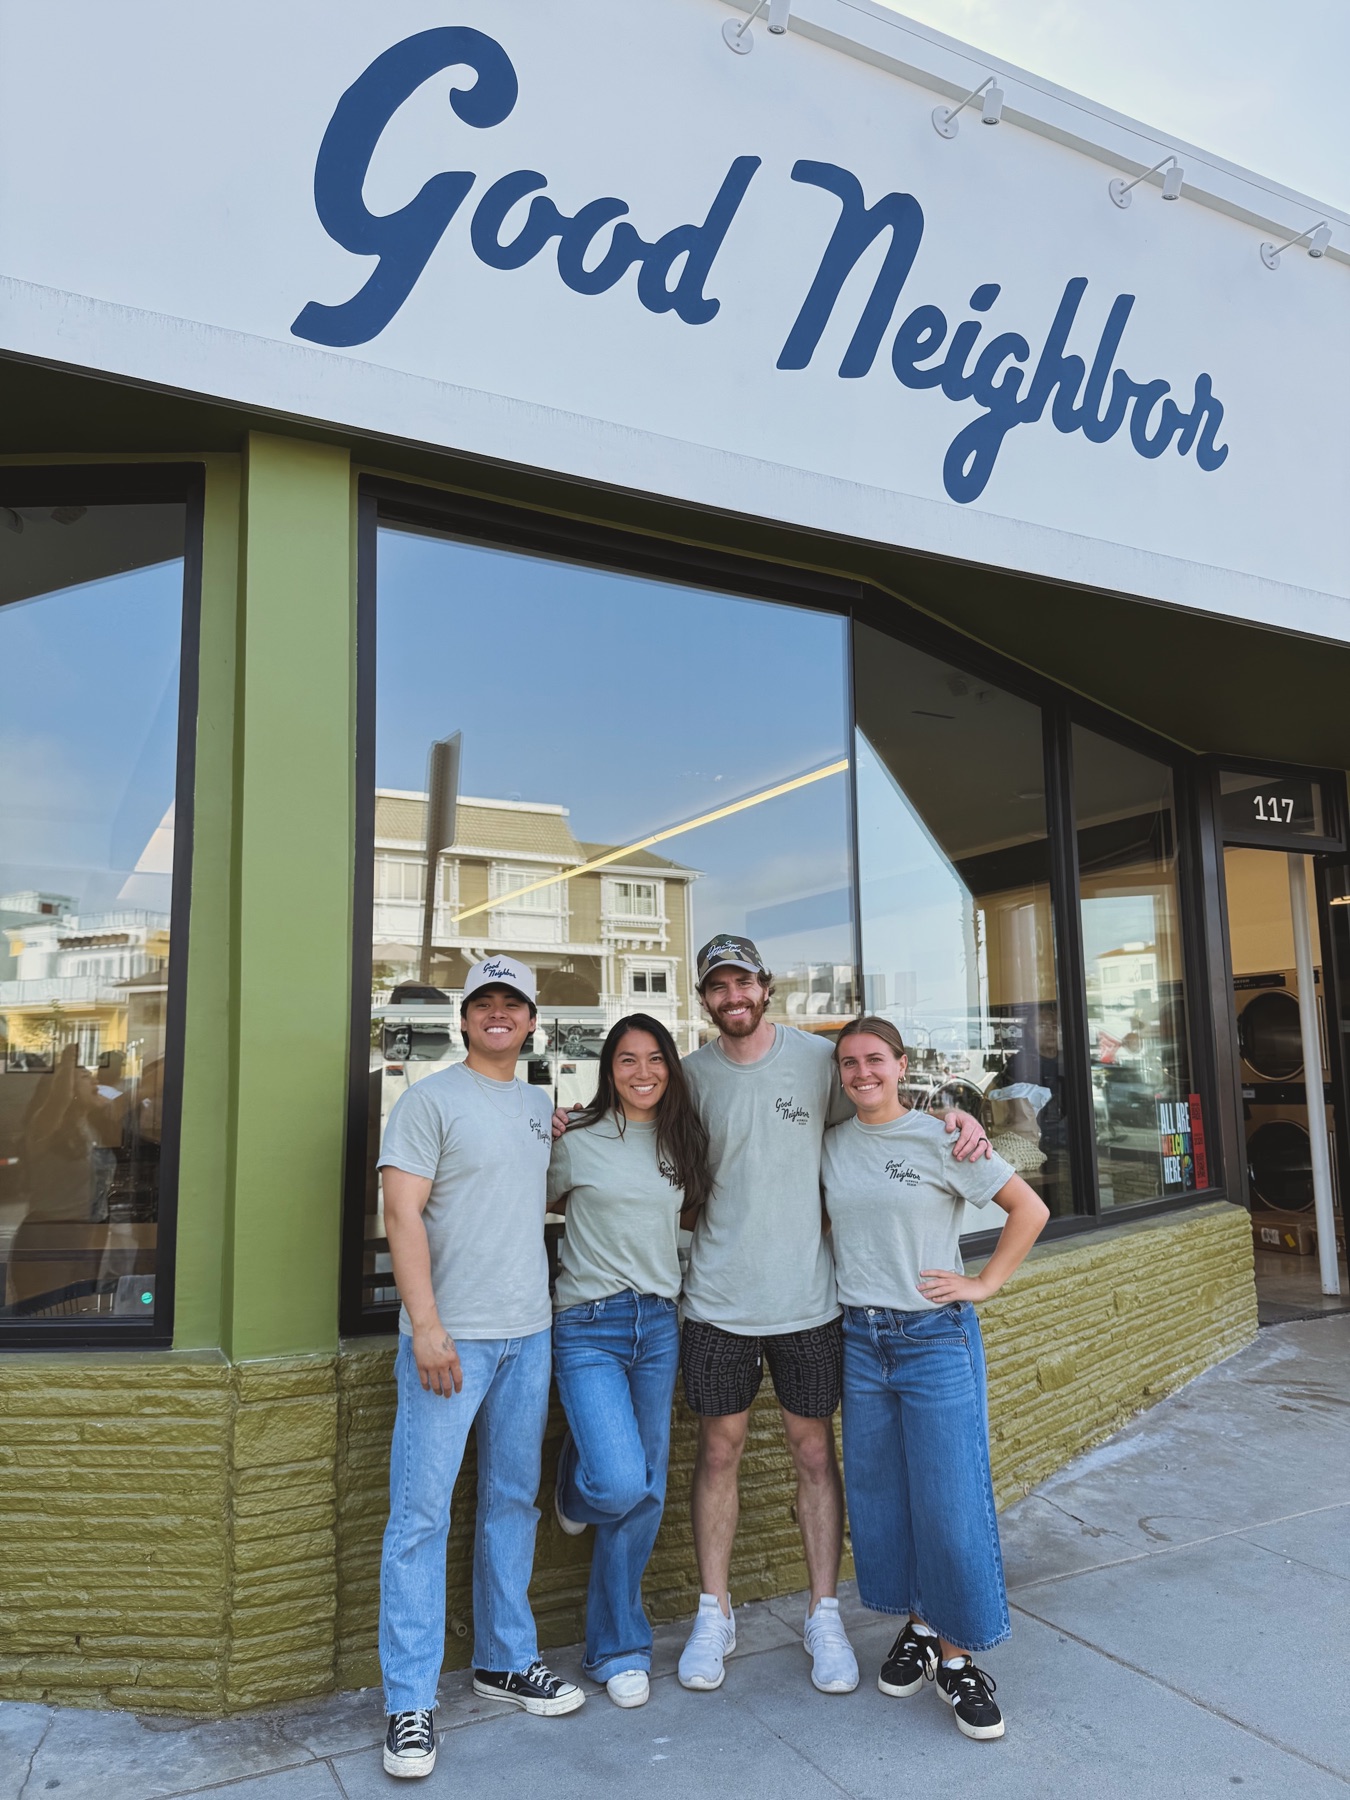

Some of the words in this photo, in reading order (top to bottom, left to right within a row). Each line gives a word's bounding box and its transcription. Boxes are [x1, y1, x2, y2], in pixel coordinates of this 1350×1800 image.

[291, 27, 761, 347] Good
[777, 160, 1228, 503] Neighbor
[1253, 795, 1294, 823] 117
[483, 961, 501, 974] Good
[776, 1096, 793, 1112] Good
[782, 1107, 810, 1122] Neighbor
[1160, 1102, 1175, 1134] ALL
[1175, 1102, 1191, 1134] ARE
[530, 1118, 541, 1132] Good
[884, 1159, 906, 1172] Good
[1164, 1155, 1182, 1184] HERE
[889, 1168, 921, 1182] Neighbor
